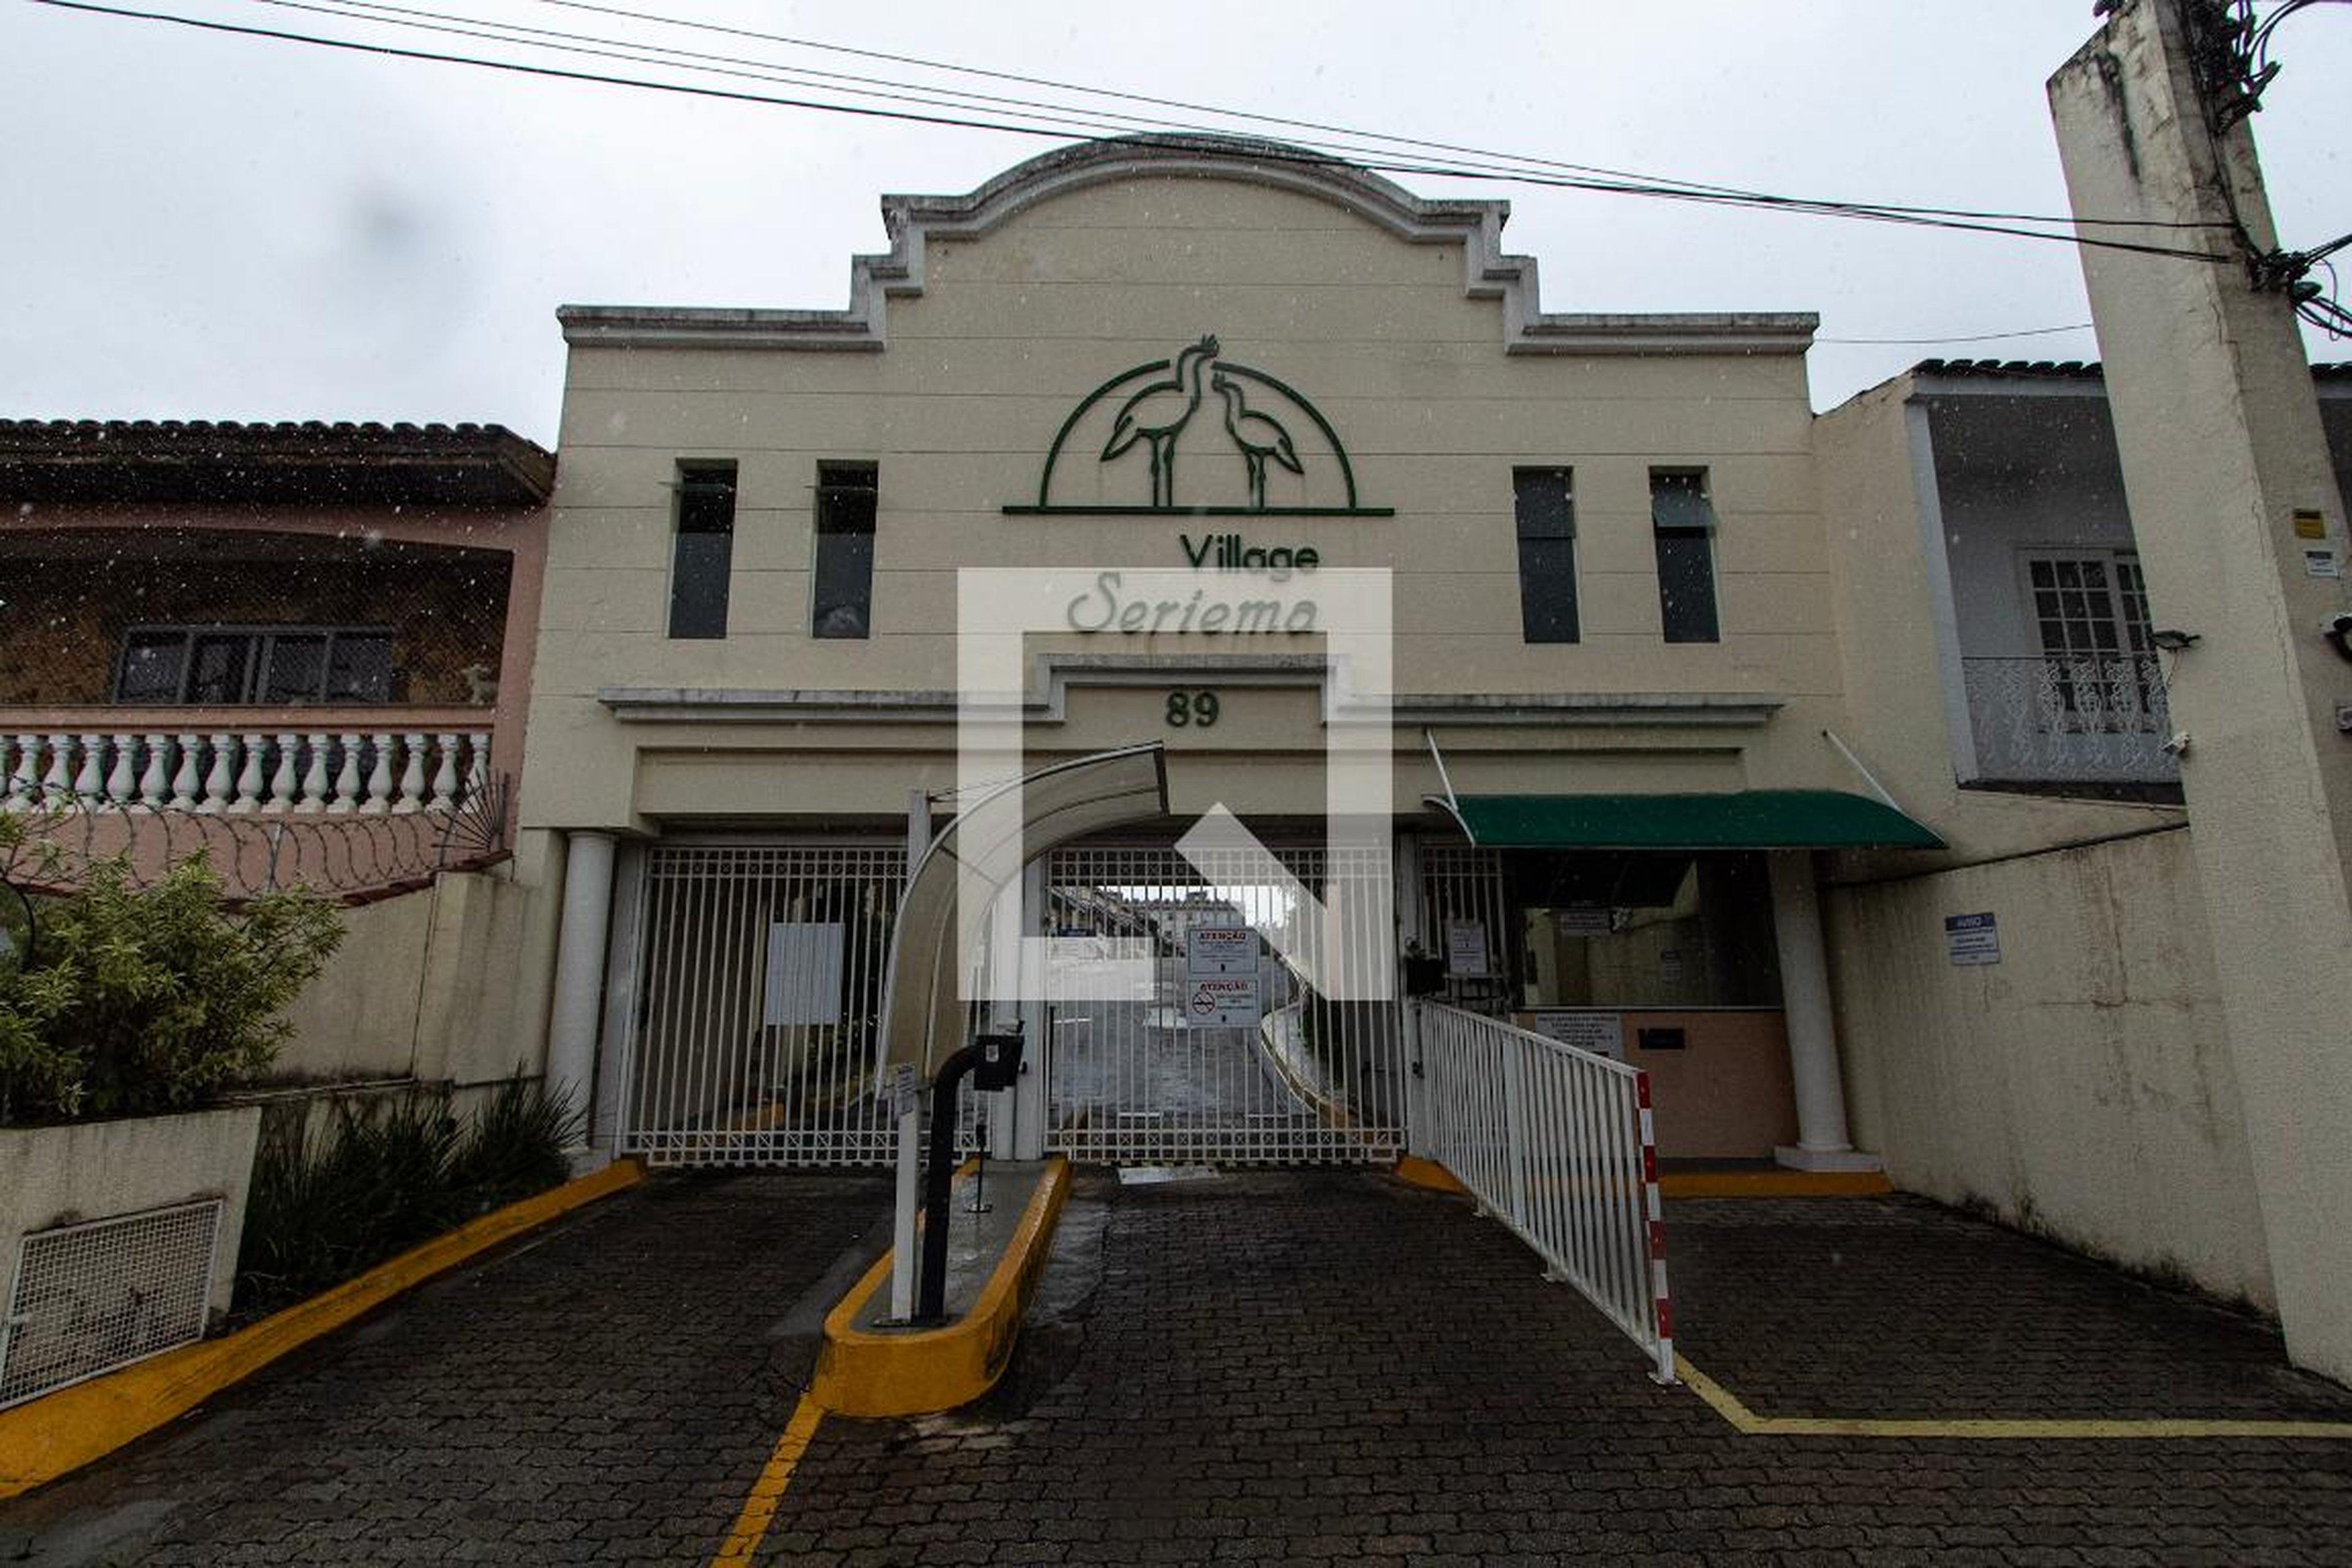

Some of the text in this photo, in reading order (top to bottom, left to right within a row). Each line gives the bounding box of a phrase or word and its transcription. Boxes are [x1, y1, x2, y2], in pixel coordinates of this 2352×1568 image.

[1180, 534, 1320, 581] Village
[1067, 571, 1317, 635] Seriema
[1166, 691, 1219, 728] 89
